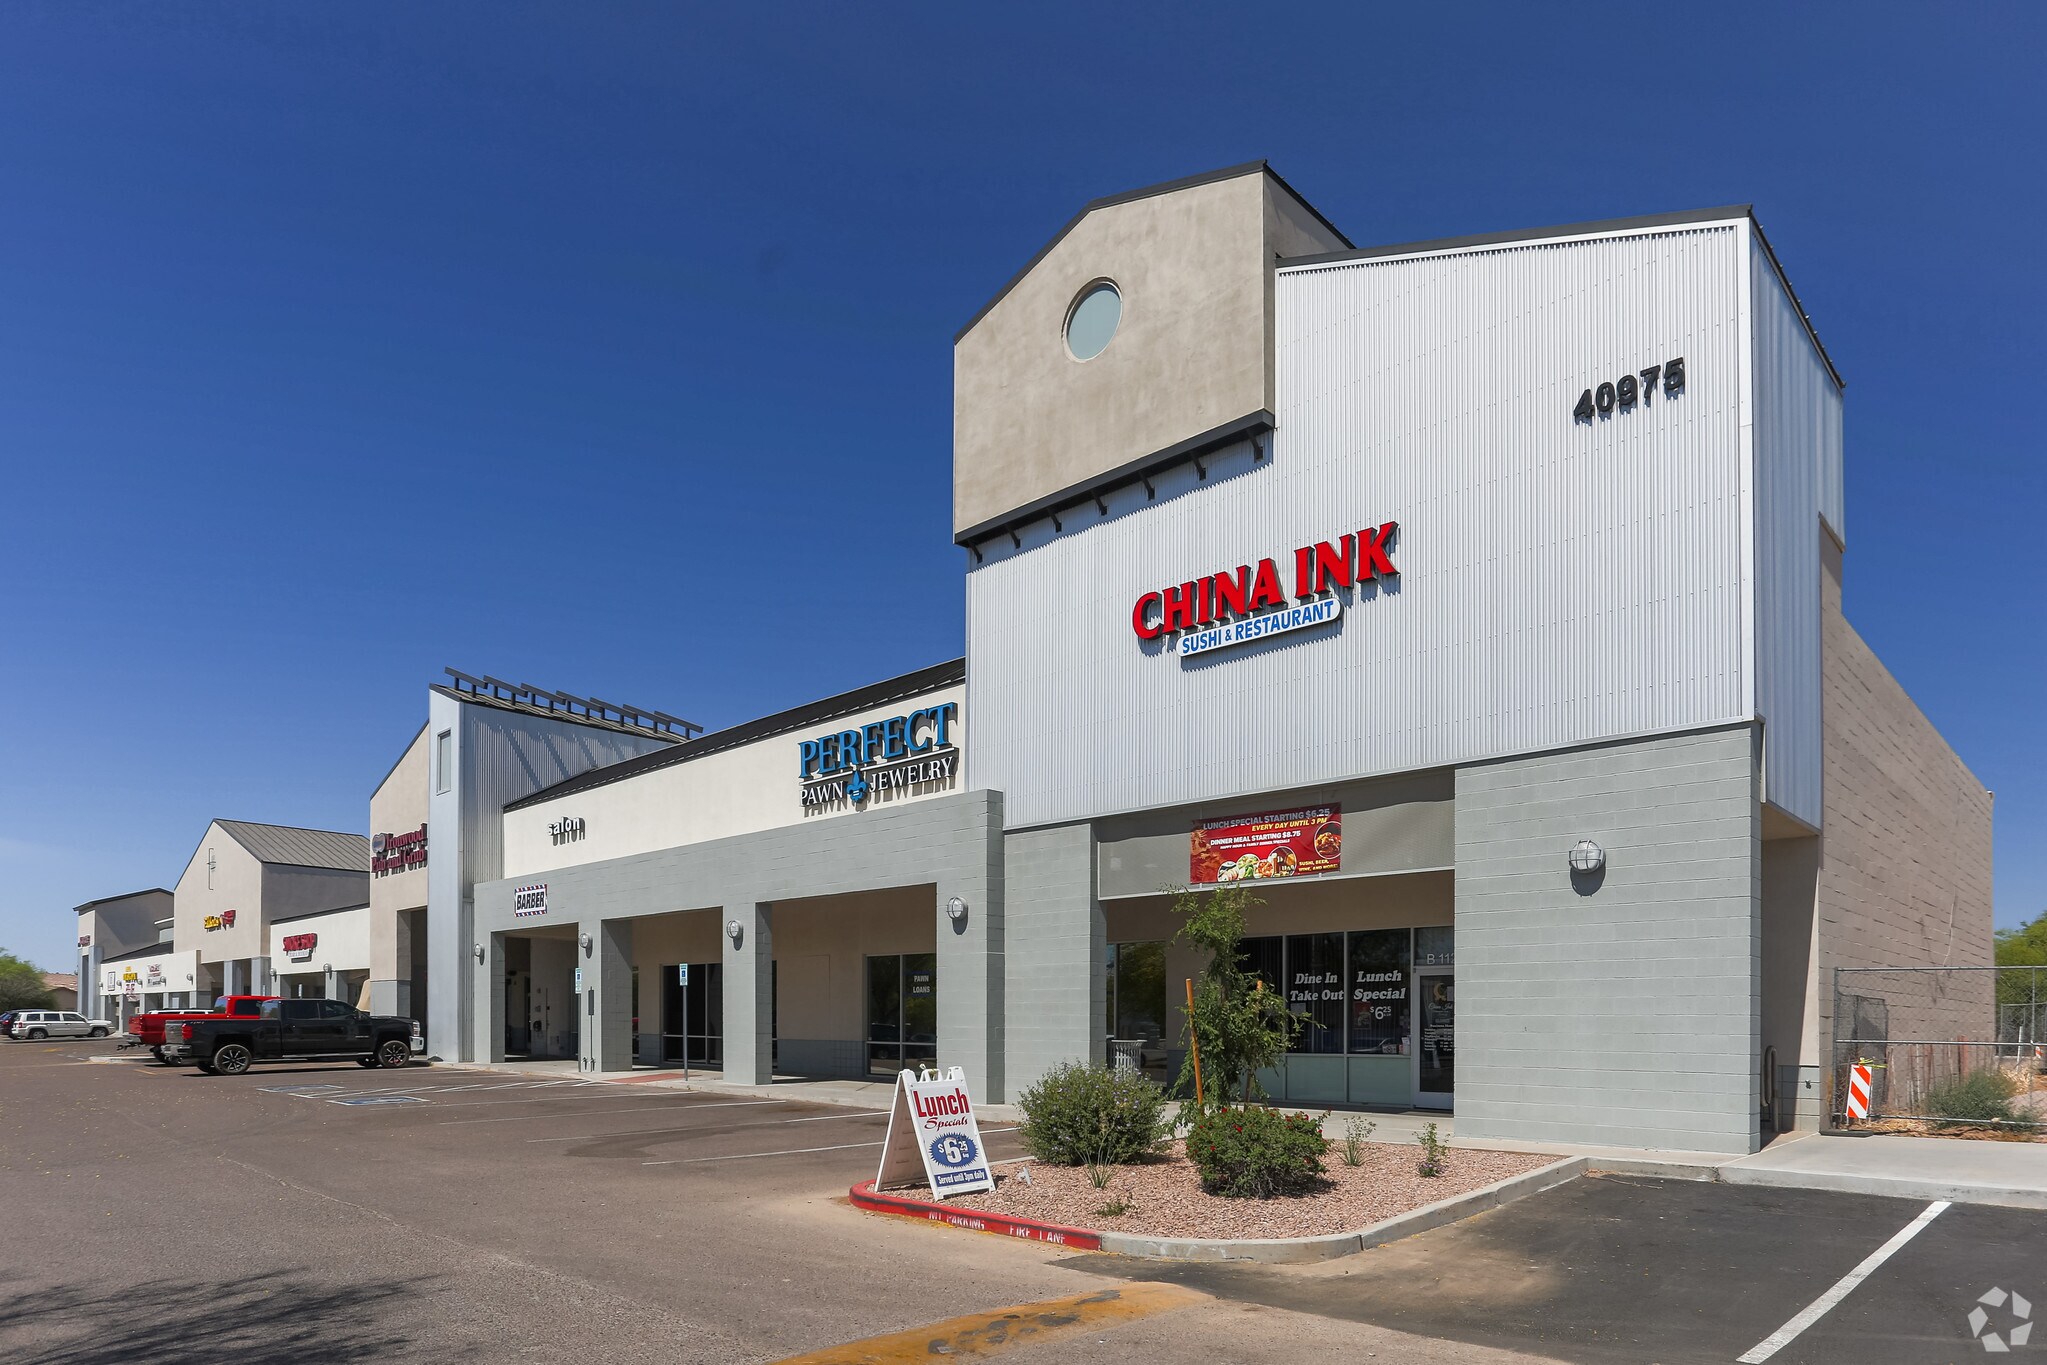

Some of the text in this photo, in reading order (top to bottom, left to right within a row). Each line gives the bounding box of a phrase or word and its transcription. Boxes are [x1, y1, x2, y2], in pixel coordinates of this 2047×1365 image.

[1573, 356, 1686, 418] 40975
[1132, 520, 1400, 640] CHINA INK
[1181, 600, 1334, 654] SUSHI & RESTAURANT
[798, 702, 955, 778] PERFECT
[799, 755, 953, 807] PAWN JEWELRY
[547, 816, 580, 836] salon
[1203, 808, 1330, 830] LUNCH SPECIAL STARTING $6.25
[1251, 823, 1274, 832] EVERY
[1274, 821, 1289, 829] DAY
[1289, 819, 1310, 828] UNTIL
[1210, 830, 1301, 846] DINNER MEAL STARTING $8.75
[516, 891, 545, 911] BARBER
[1426, 953, 1435, 964] B
[1295, 972, 1338, 985] Dine In
[1356, 970, 1402, 983] Lunch
[1290, 989, 1344, 1001] Take Out
[1353, 987, 1406, 1002] Special
[913, 1087, 970, 1118] Lunch
[924, 1115, 968, 1132] Specials
[937, 1174, 954, 1184] Served
[953, 1173, 964, 1182] until
[974, 1170, 985, 1180] daily
[1009, 1224, 1031, 1238] FIRE
